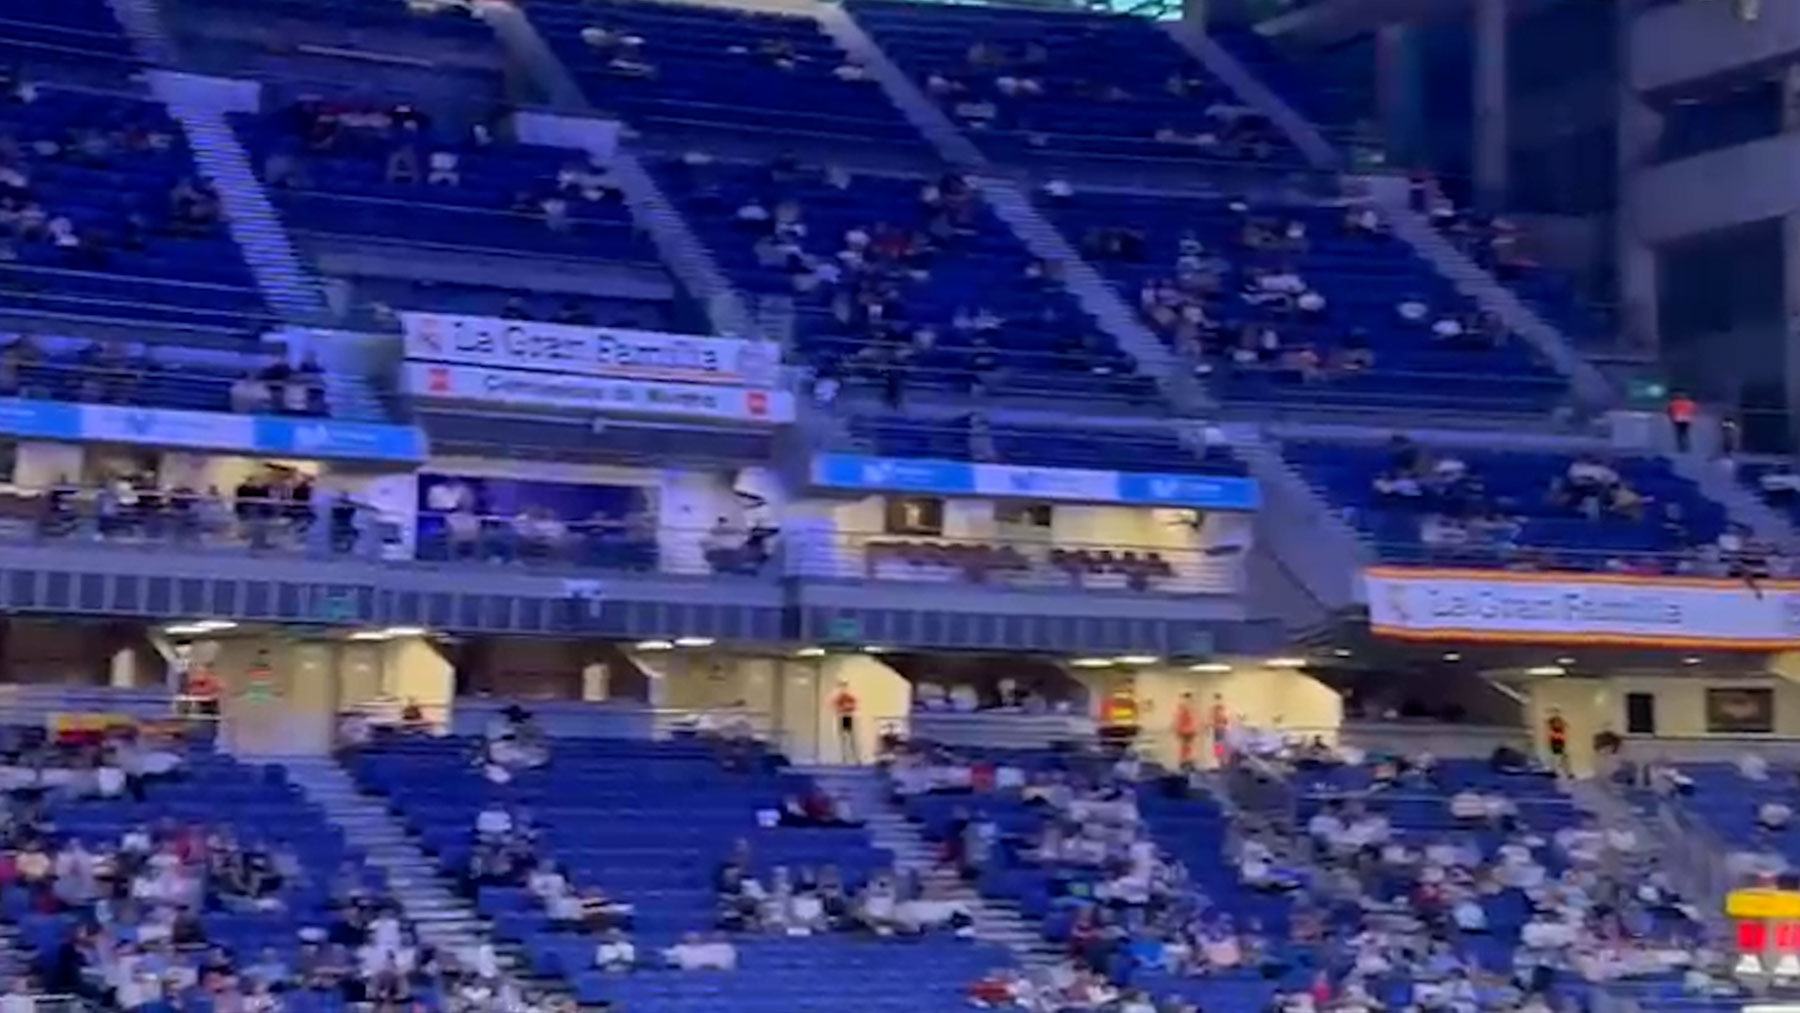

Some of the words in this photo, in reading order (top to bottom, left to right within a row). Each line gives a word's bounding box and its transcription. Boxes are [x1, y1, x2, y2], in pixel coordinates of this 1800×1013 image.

[454, 321, 493, 353] La
[505, 325, 586, 360] Gran
[1429, 588, 1468, 618] La
